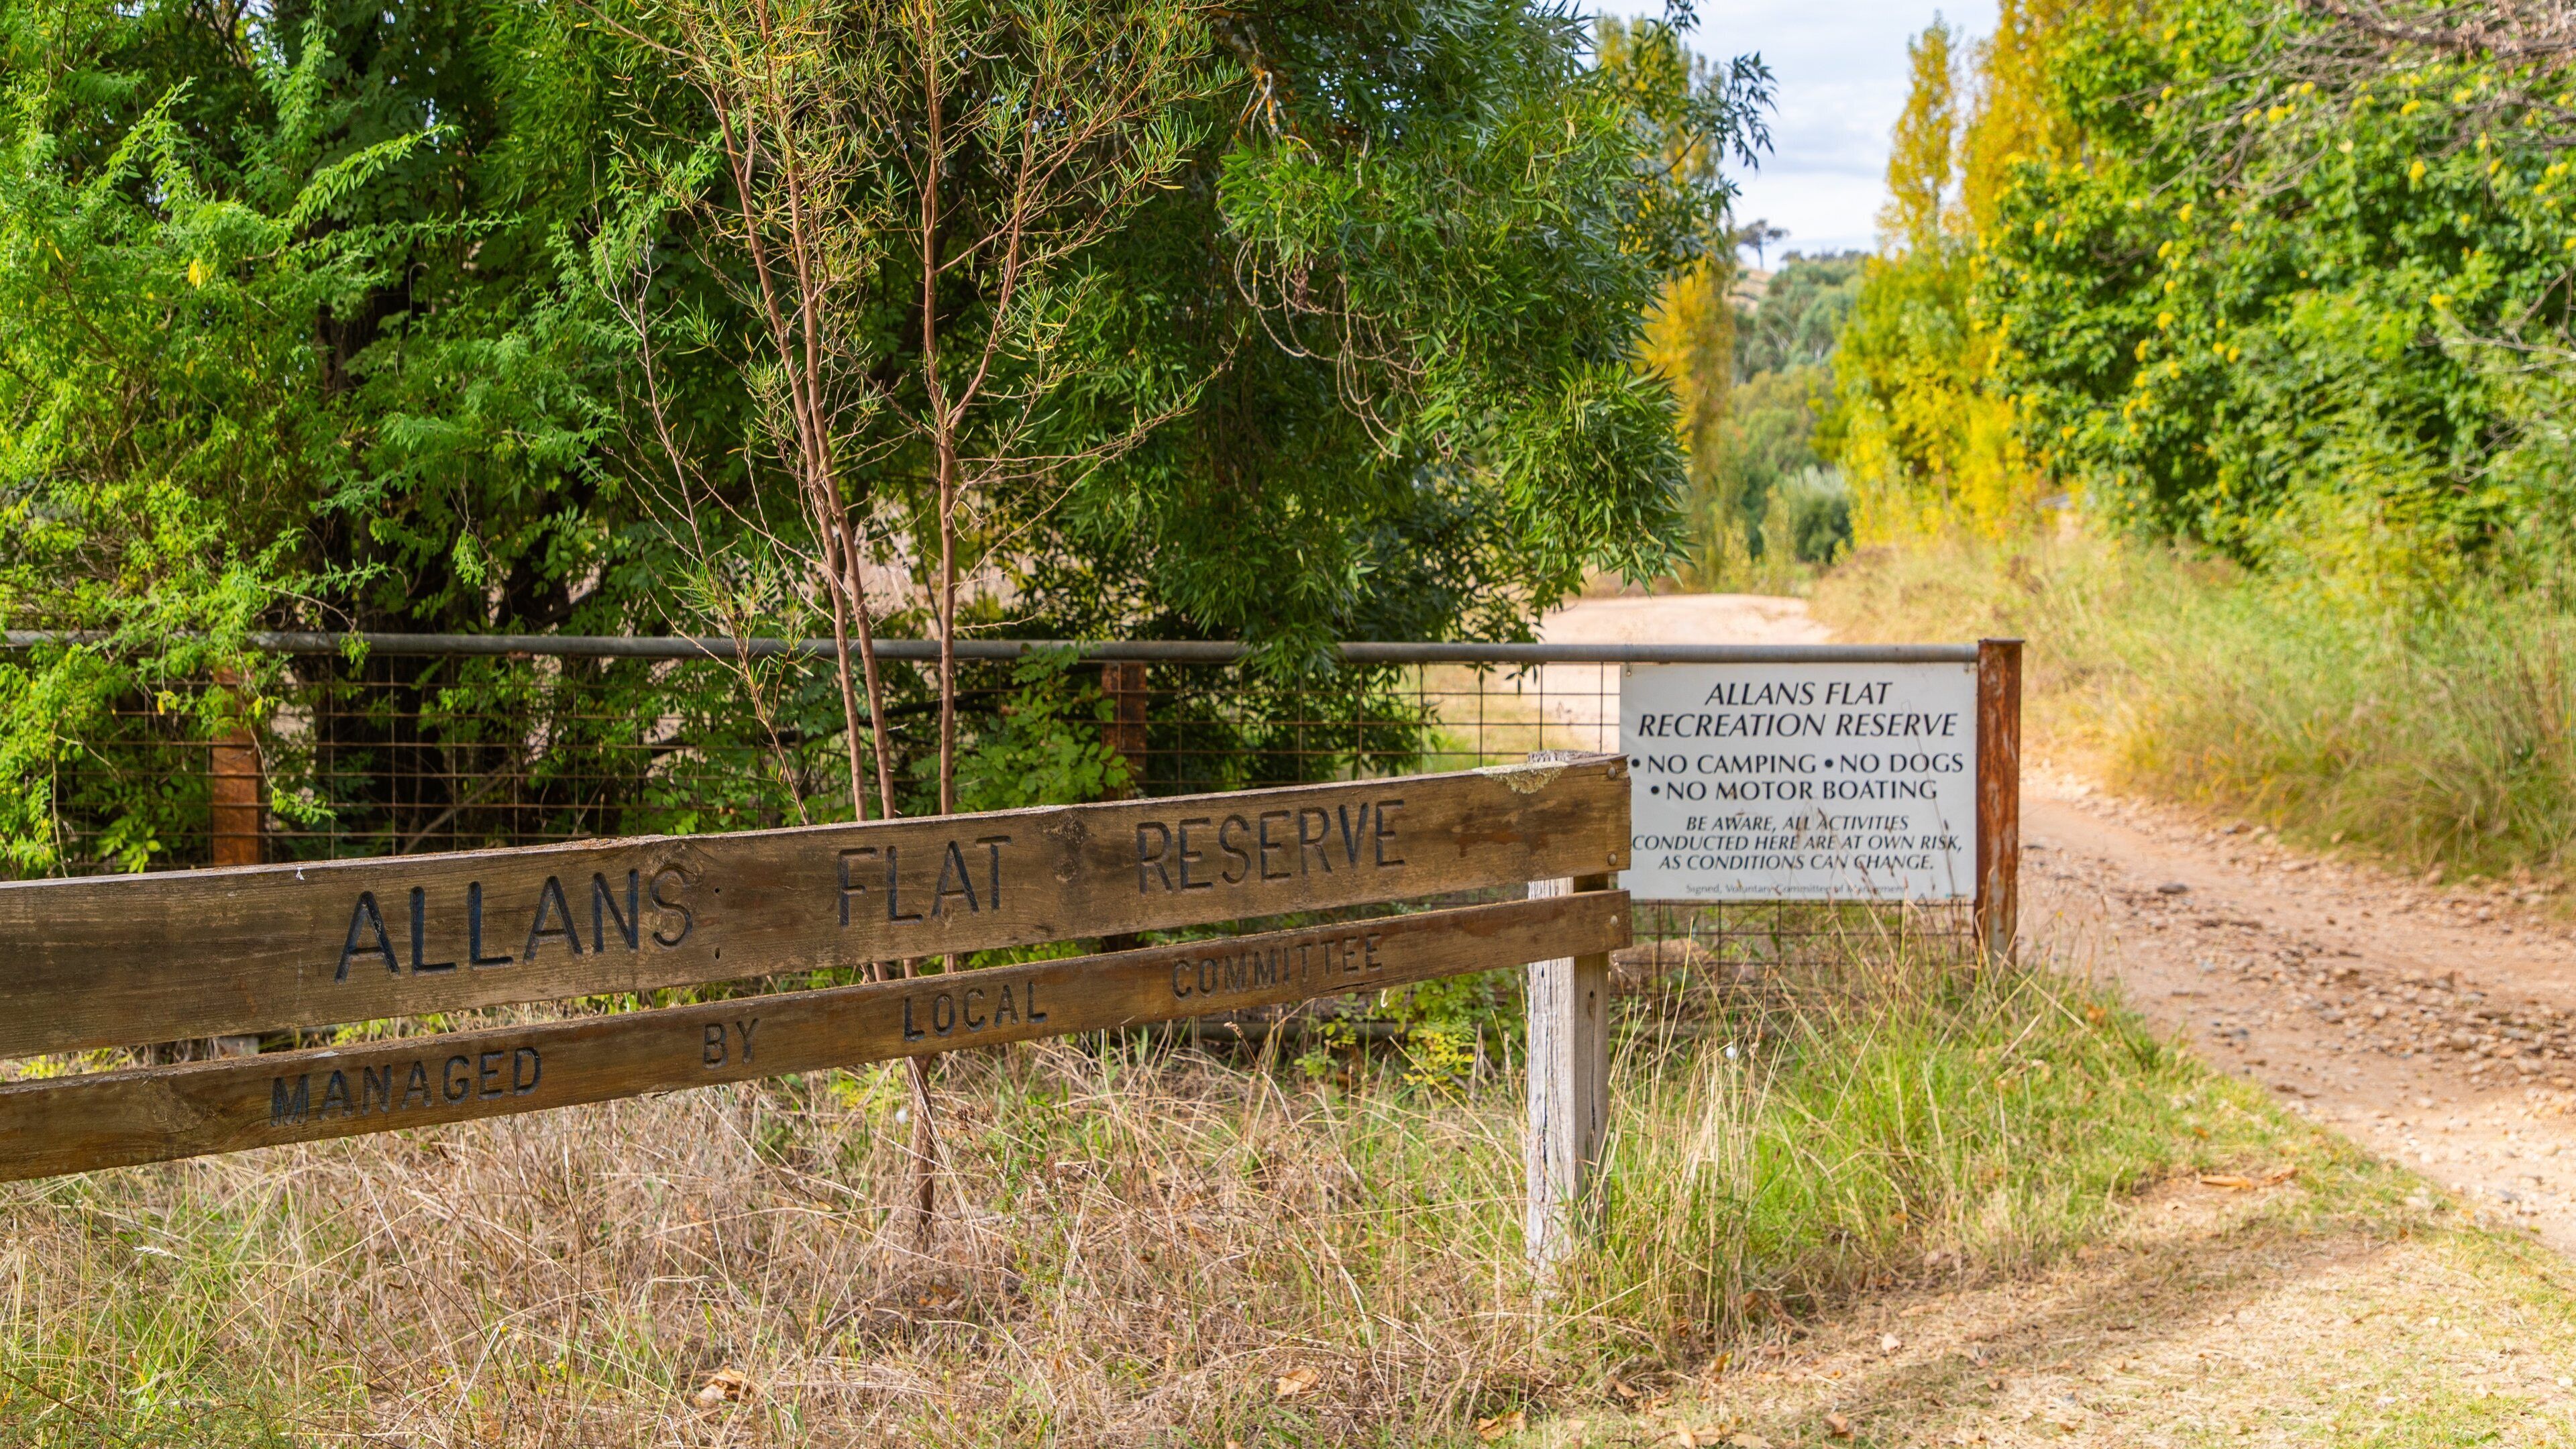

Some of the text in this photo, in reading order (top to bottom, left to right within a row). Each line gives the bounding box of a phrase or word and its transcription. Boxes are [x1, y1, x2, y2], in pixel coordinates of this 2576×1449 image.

[1705, 682, 1893, 706] ALLANS FLAT
[1639, 712, 1958, 737] RECREATION RESERVE
[1648, 753, 1964, 774] NO CAMPING NO DOGS
[1666, 780, 1937, 801] NO MOTOR BOATING
[1686, 814, 1910, 835] BE AWARE, ALL ACTIVITIES
[1633, 835, 1962, 853] CONDUCTED HERE ARE AT OWN RISK,
[1658, 854, 1934, 871] AS CONDITIONS CAN CHANGE.
[335, 799, 1406, 985] ALLANS FLAT RESERVE
[269, 932, 1383, 1127] MANAGED BY LOCAL COMMITTEE
